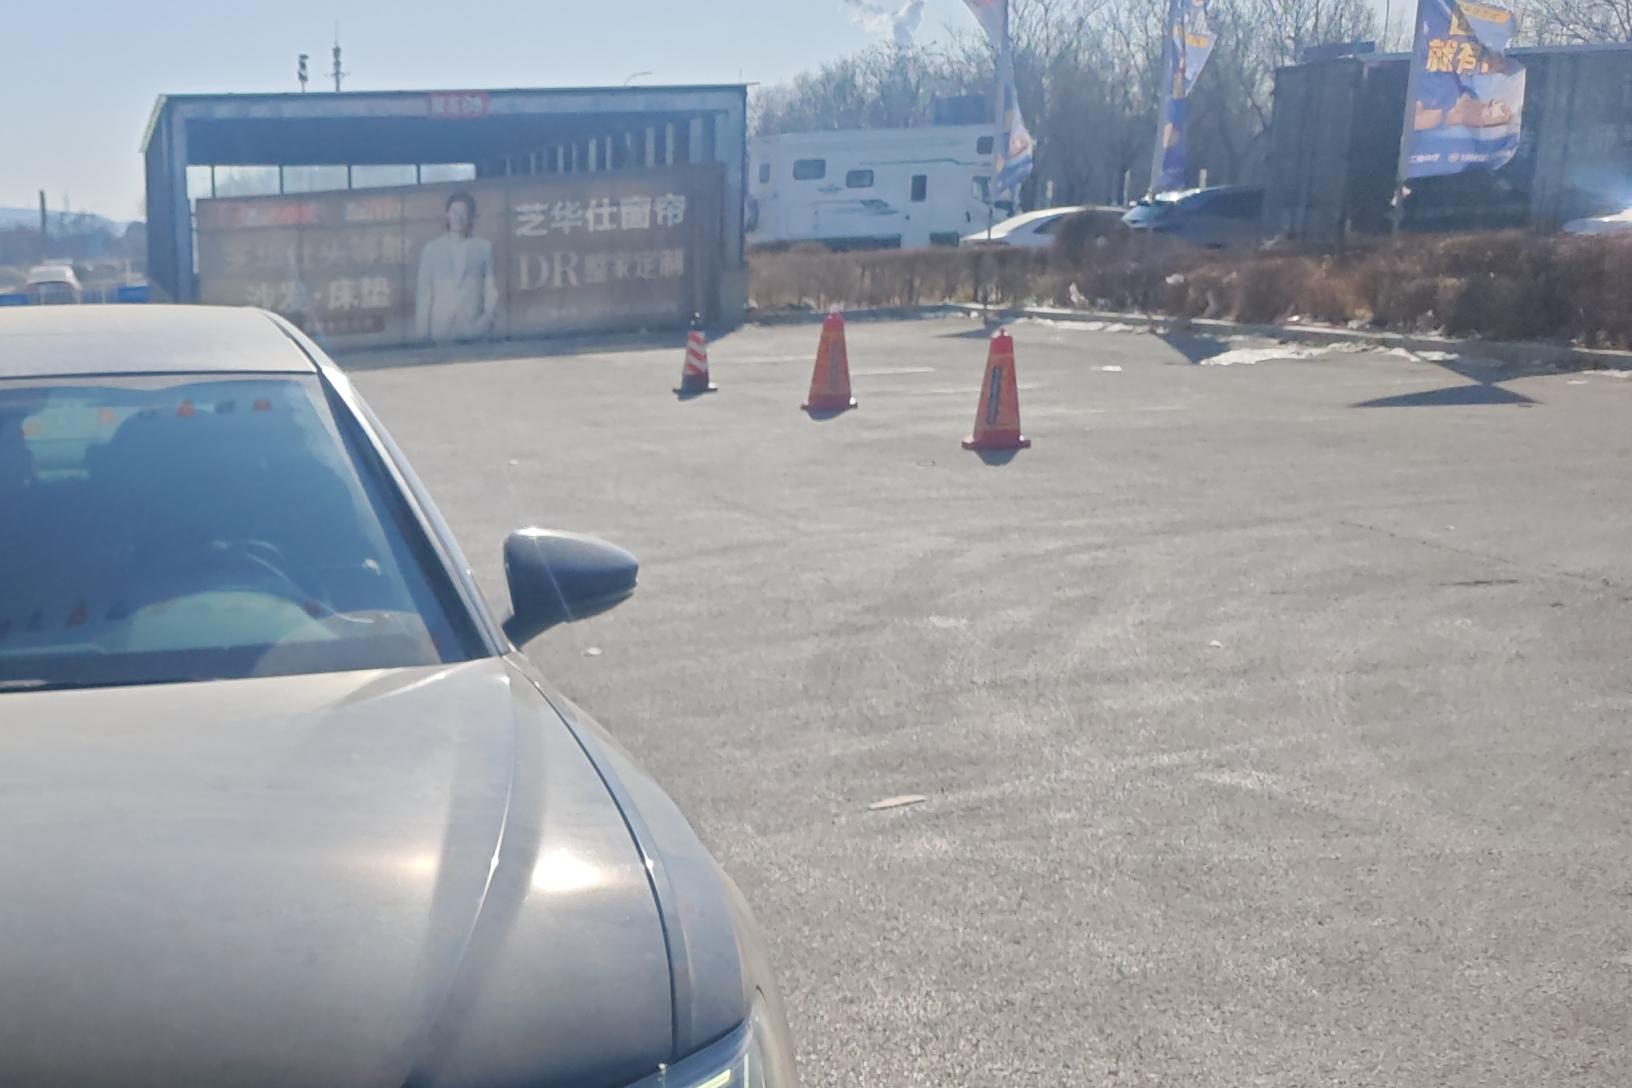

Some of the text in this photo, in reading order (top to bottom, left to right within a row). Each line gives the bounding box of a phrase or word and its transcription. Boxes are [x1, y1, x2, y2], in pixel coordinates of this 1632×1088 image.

[514, 192, 687, 237] 芝华仕窗帘
[518, 252, 581, 291] DR
